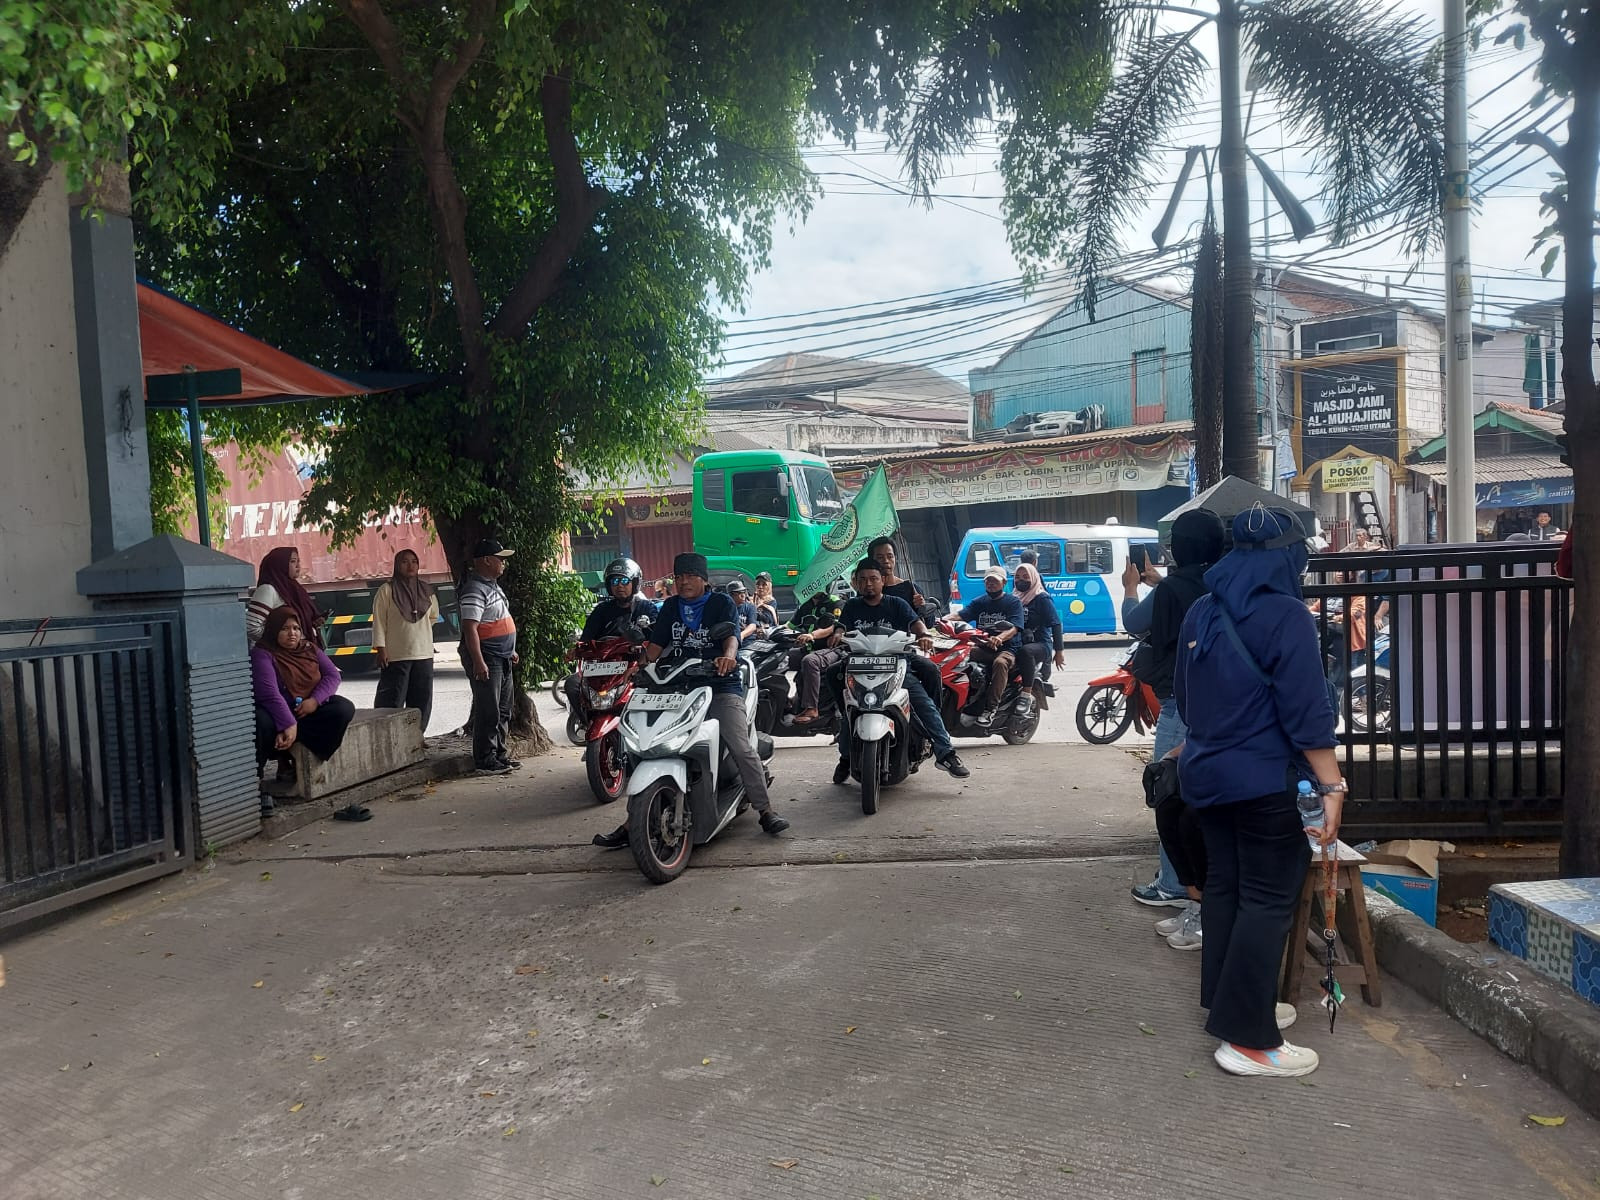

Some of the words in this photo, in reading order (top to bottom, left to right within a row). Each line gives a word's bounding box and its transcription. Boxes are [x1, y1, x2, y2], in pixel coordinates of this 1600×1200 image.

[1313, 398, 1355, 413] MASJID
[1357, 394, 1385, 409] JAMI
[928, 473, 987, 486] SPAREPARTS
[995, 470, 1015, 479] BAK
[1023, 467, 1054, 477] CABIN
[1062, 462, 1100, 473] TERIMA
[1329, 465, 1368, 478] POSKO
